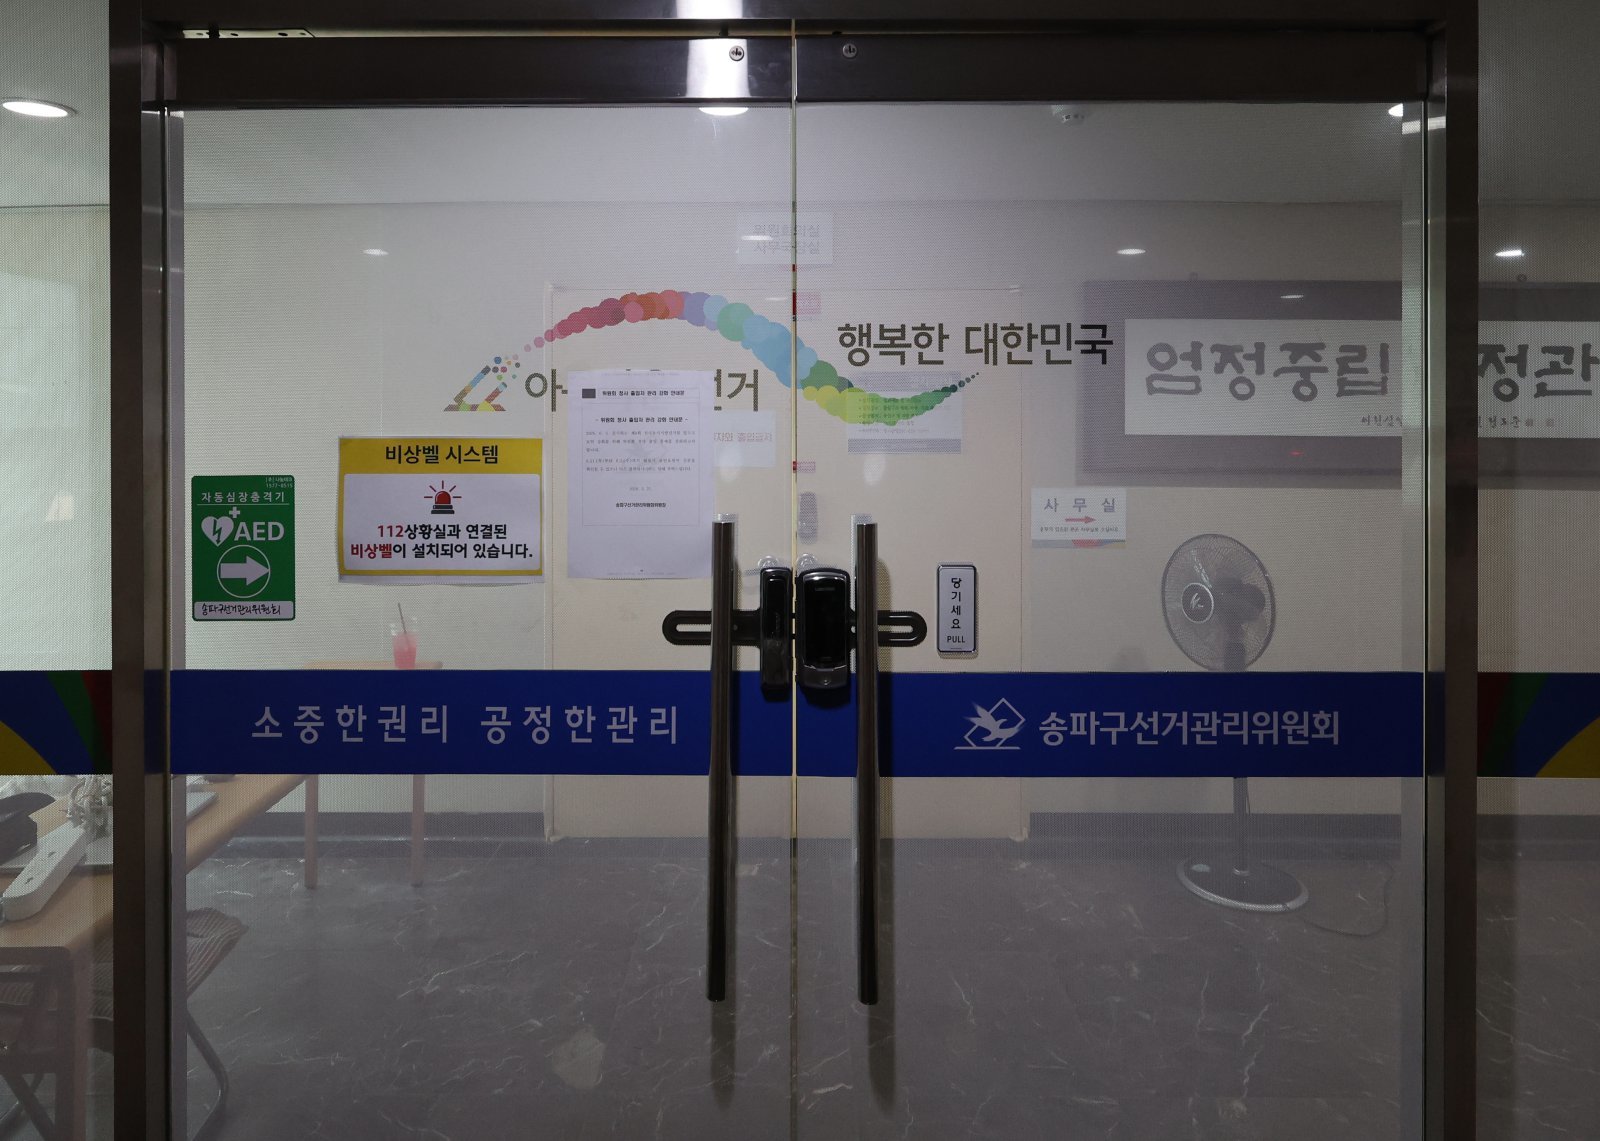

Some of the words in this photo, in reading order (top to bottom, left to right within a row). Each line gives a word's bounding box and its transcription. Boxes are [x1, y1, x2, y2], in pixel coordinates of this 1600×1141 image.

[837, 322, 950, 367] 행복한
[965, 322, 1114, 366] 대한민국
[1145, 340, 1391, 402] 엄정중립
[1478, 342, 1600, 402] 정관
[385, 444, 440, 465] 비상벨
[445, 444, 499, 465] 시스템
[201, 491, 285, 503] 자동심장충격기
[233, 521, 285, 541] AED
[377, 523, 462, 540] 112상황실과
[465, 523, 508, 540] 연결된
[350, 542, 407, 560] 비상벨이
[411, 542, 469, 560] 설치되어
[473, 542, 534, 560] 있습니다.
[950, 577, 962, 630] 당기세요
[946, 635, 966, 644] PULL
[251, 704, 448, 744] 소중한권리
[480, 704, 678, 744] 공정한관리
[1038, 710, 1340, 746] 송파구선거관리위원회
